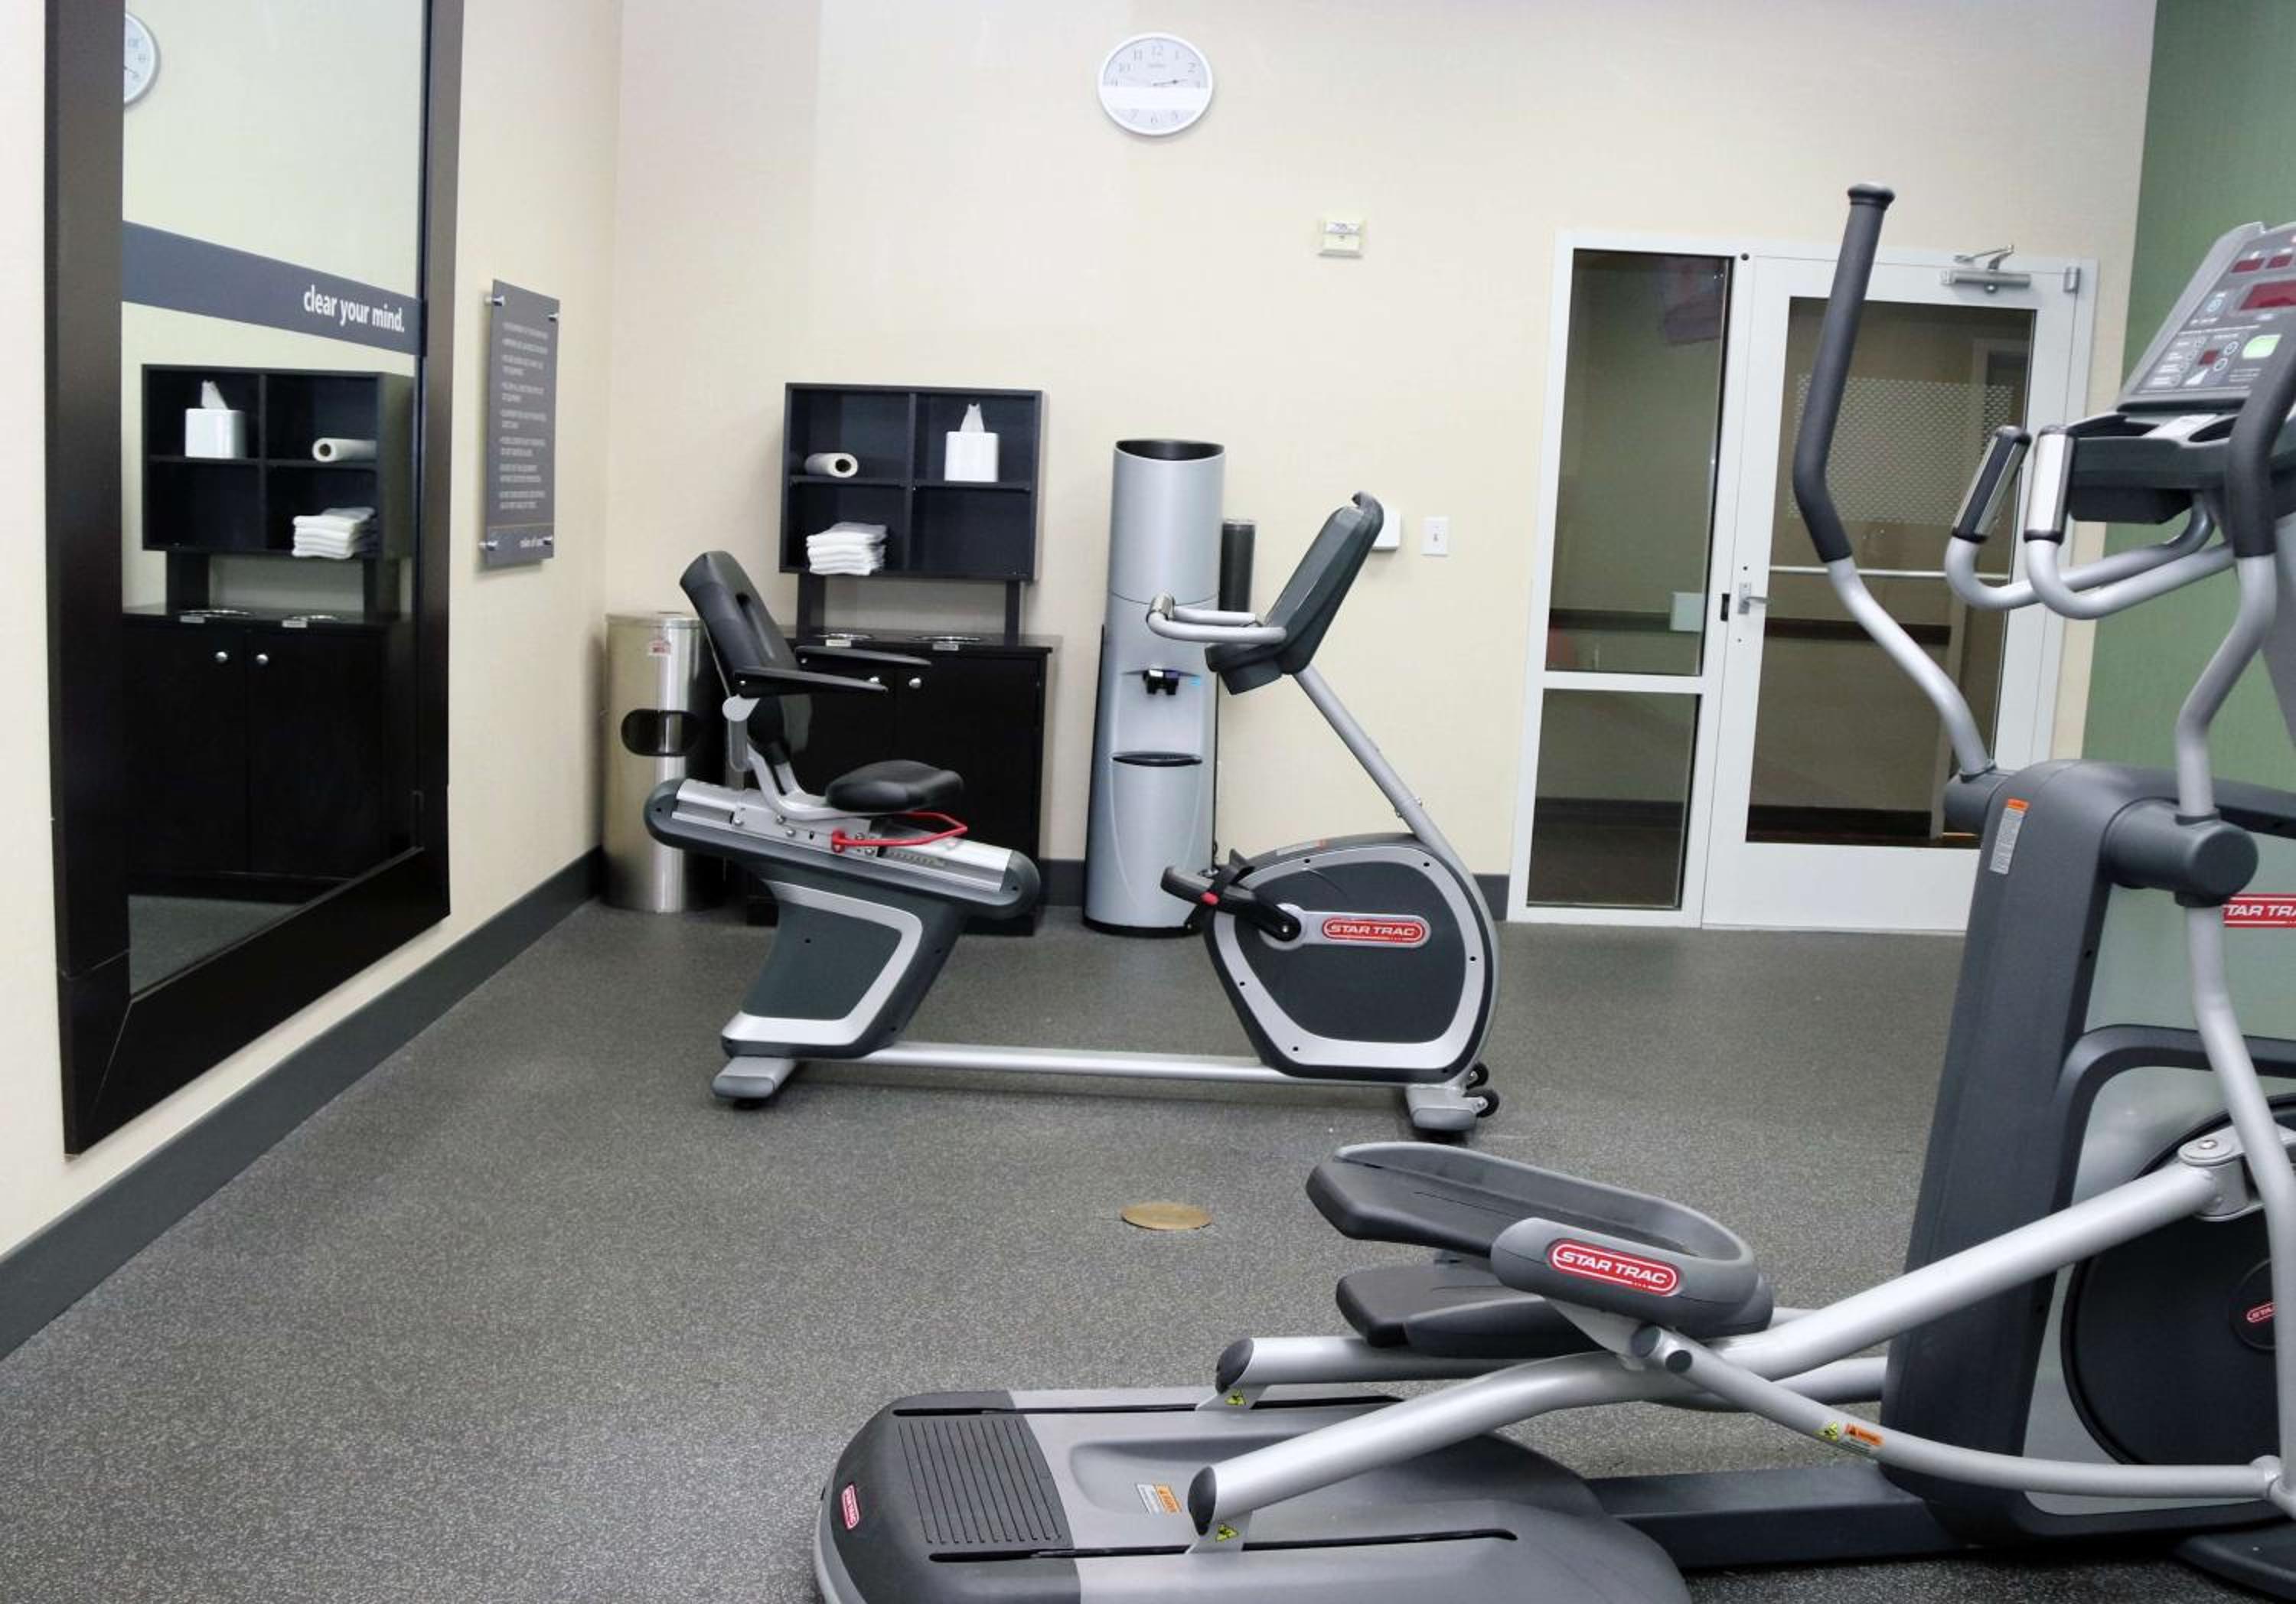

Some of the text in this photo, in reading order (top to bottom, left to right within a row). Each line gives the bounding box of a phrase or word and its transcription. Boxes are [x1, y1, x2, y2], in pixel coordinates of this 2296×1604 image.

[304, 284, 406, 333] clear your mind.
[1329, 923, 1415, 937] STAR TRAC
[1560, 1250, 1668, 1284] STAR TRAC
